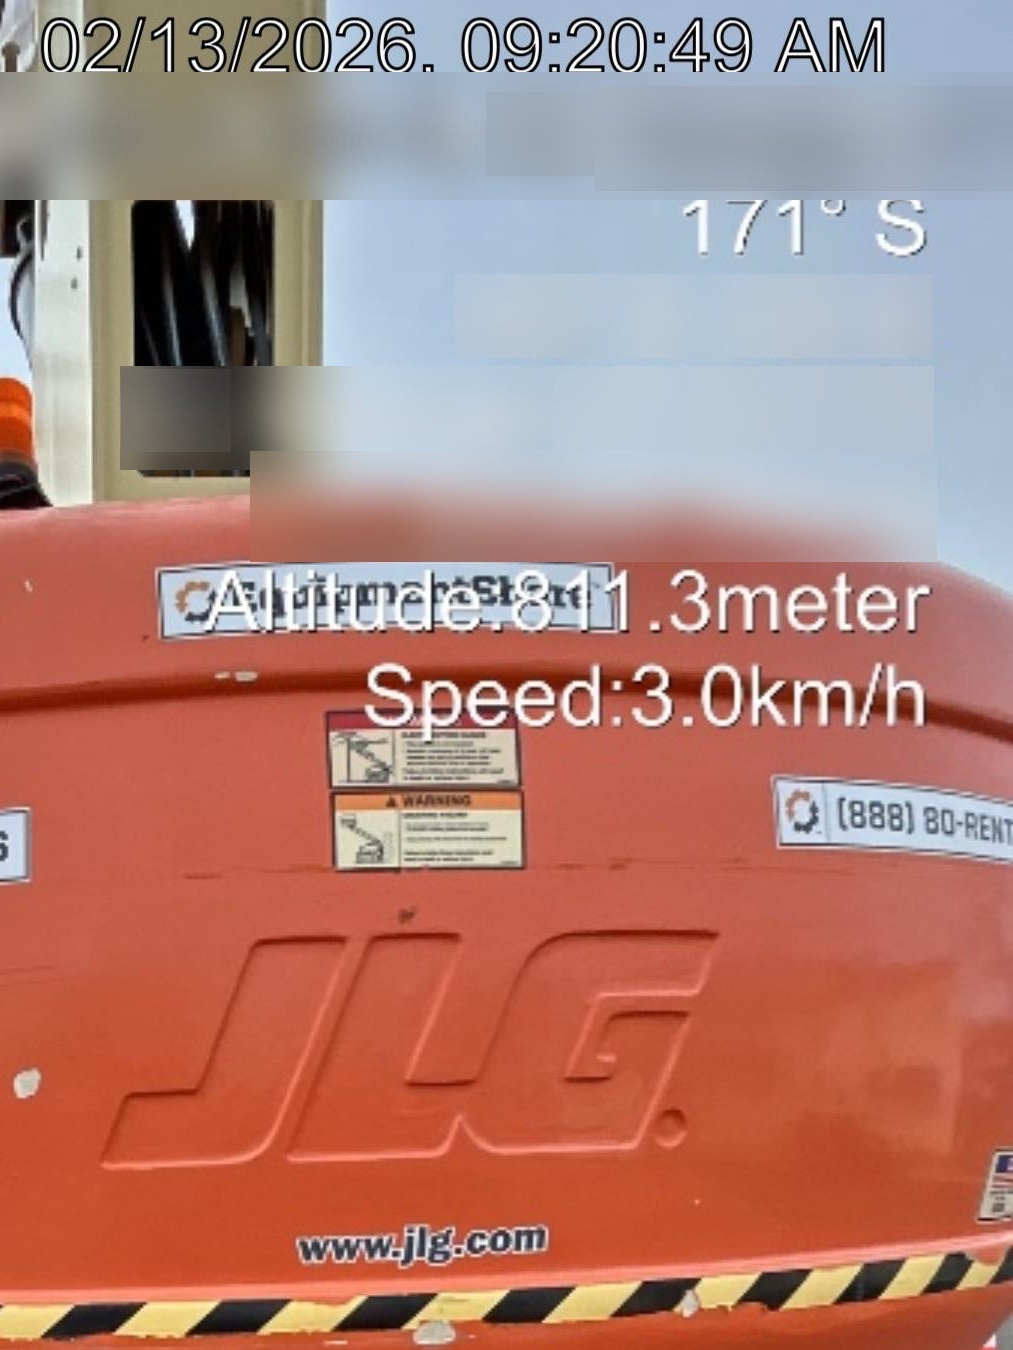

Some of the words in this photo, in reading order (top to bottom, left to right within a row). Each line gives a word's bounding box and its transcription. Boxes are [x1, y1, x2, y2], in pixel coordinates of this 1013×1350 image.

[402, 795, 472, 808] WARNING
[838, 797, 915, 834] (888)
[296, 1225, 549, 1268] www.jlg.com
